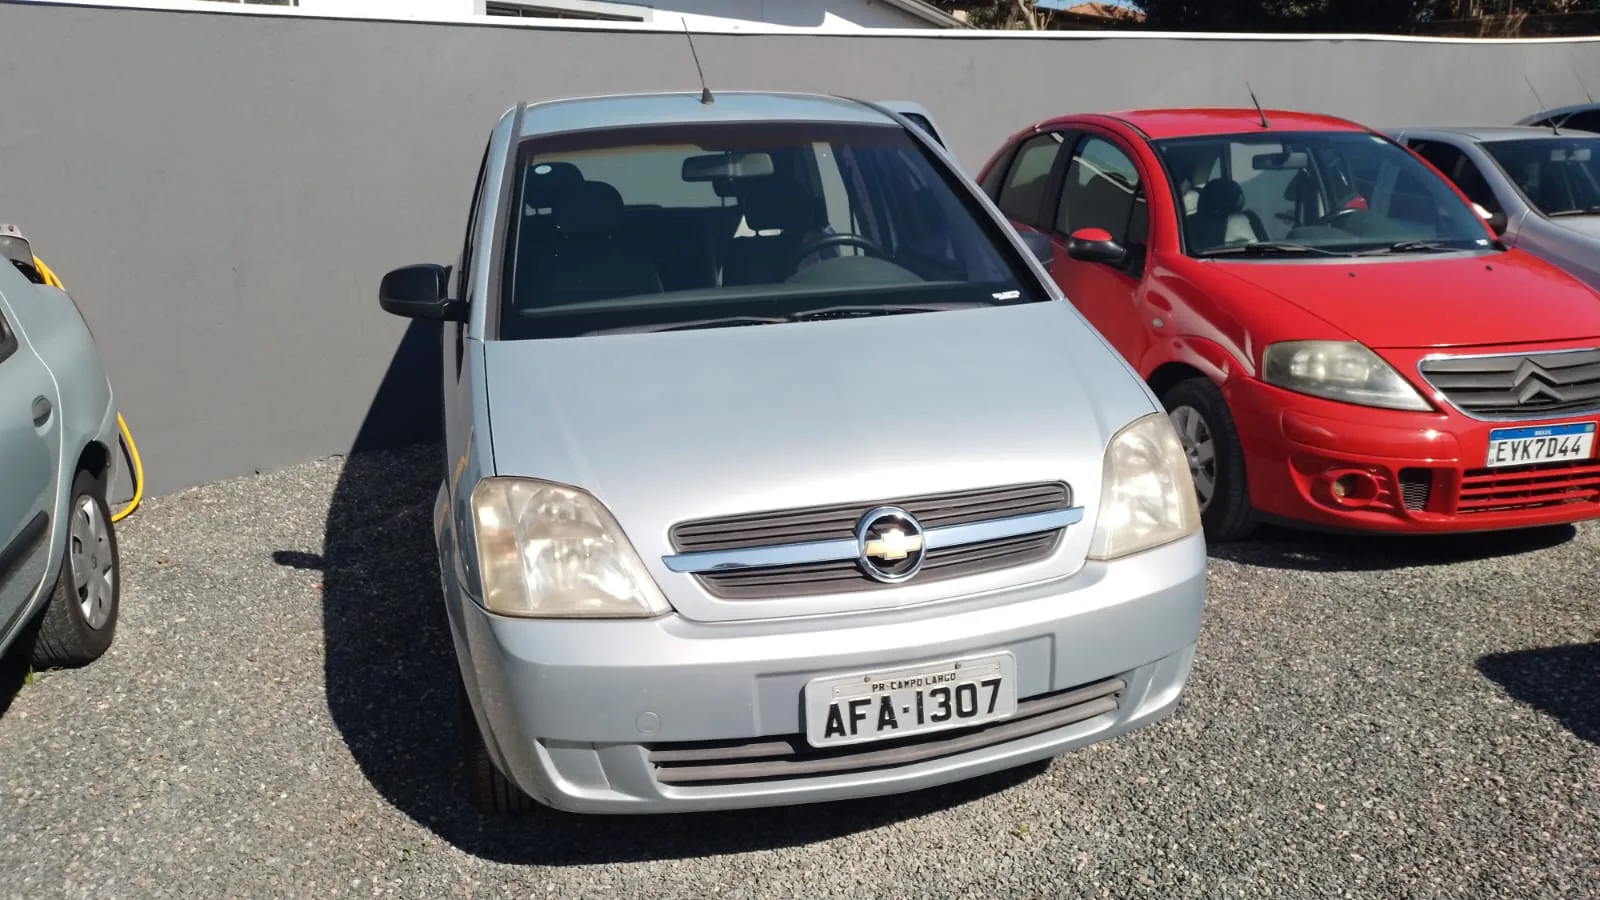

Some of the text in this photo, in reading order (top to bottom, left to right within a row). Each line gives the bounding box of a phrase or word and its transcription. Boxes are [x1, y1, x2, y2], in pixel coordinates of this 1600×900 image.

[1496, 436, 1582, 462] EYK7D44
[925, 672, 956, 685] LARGO
[824, 677, 1002, 739] AFA-1307
